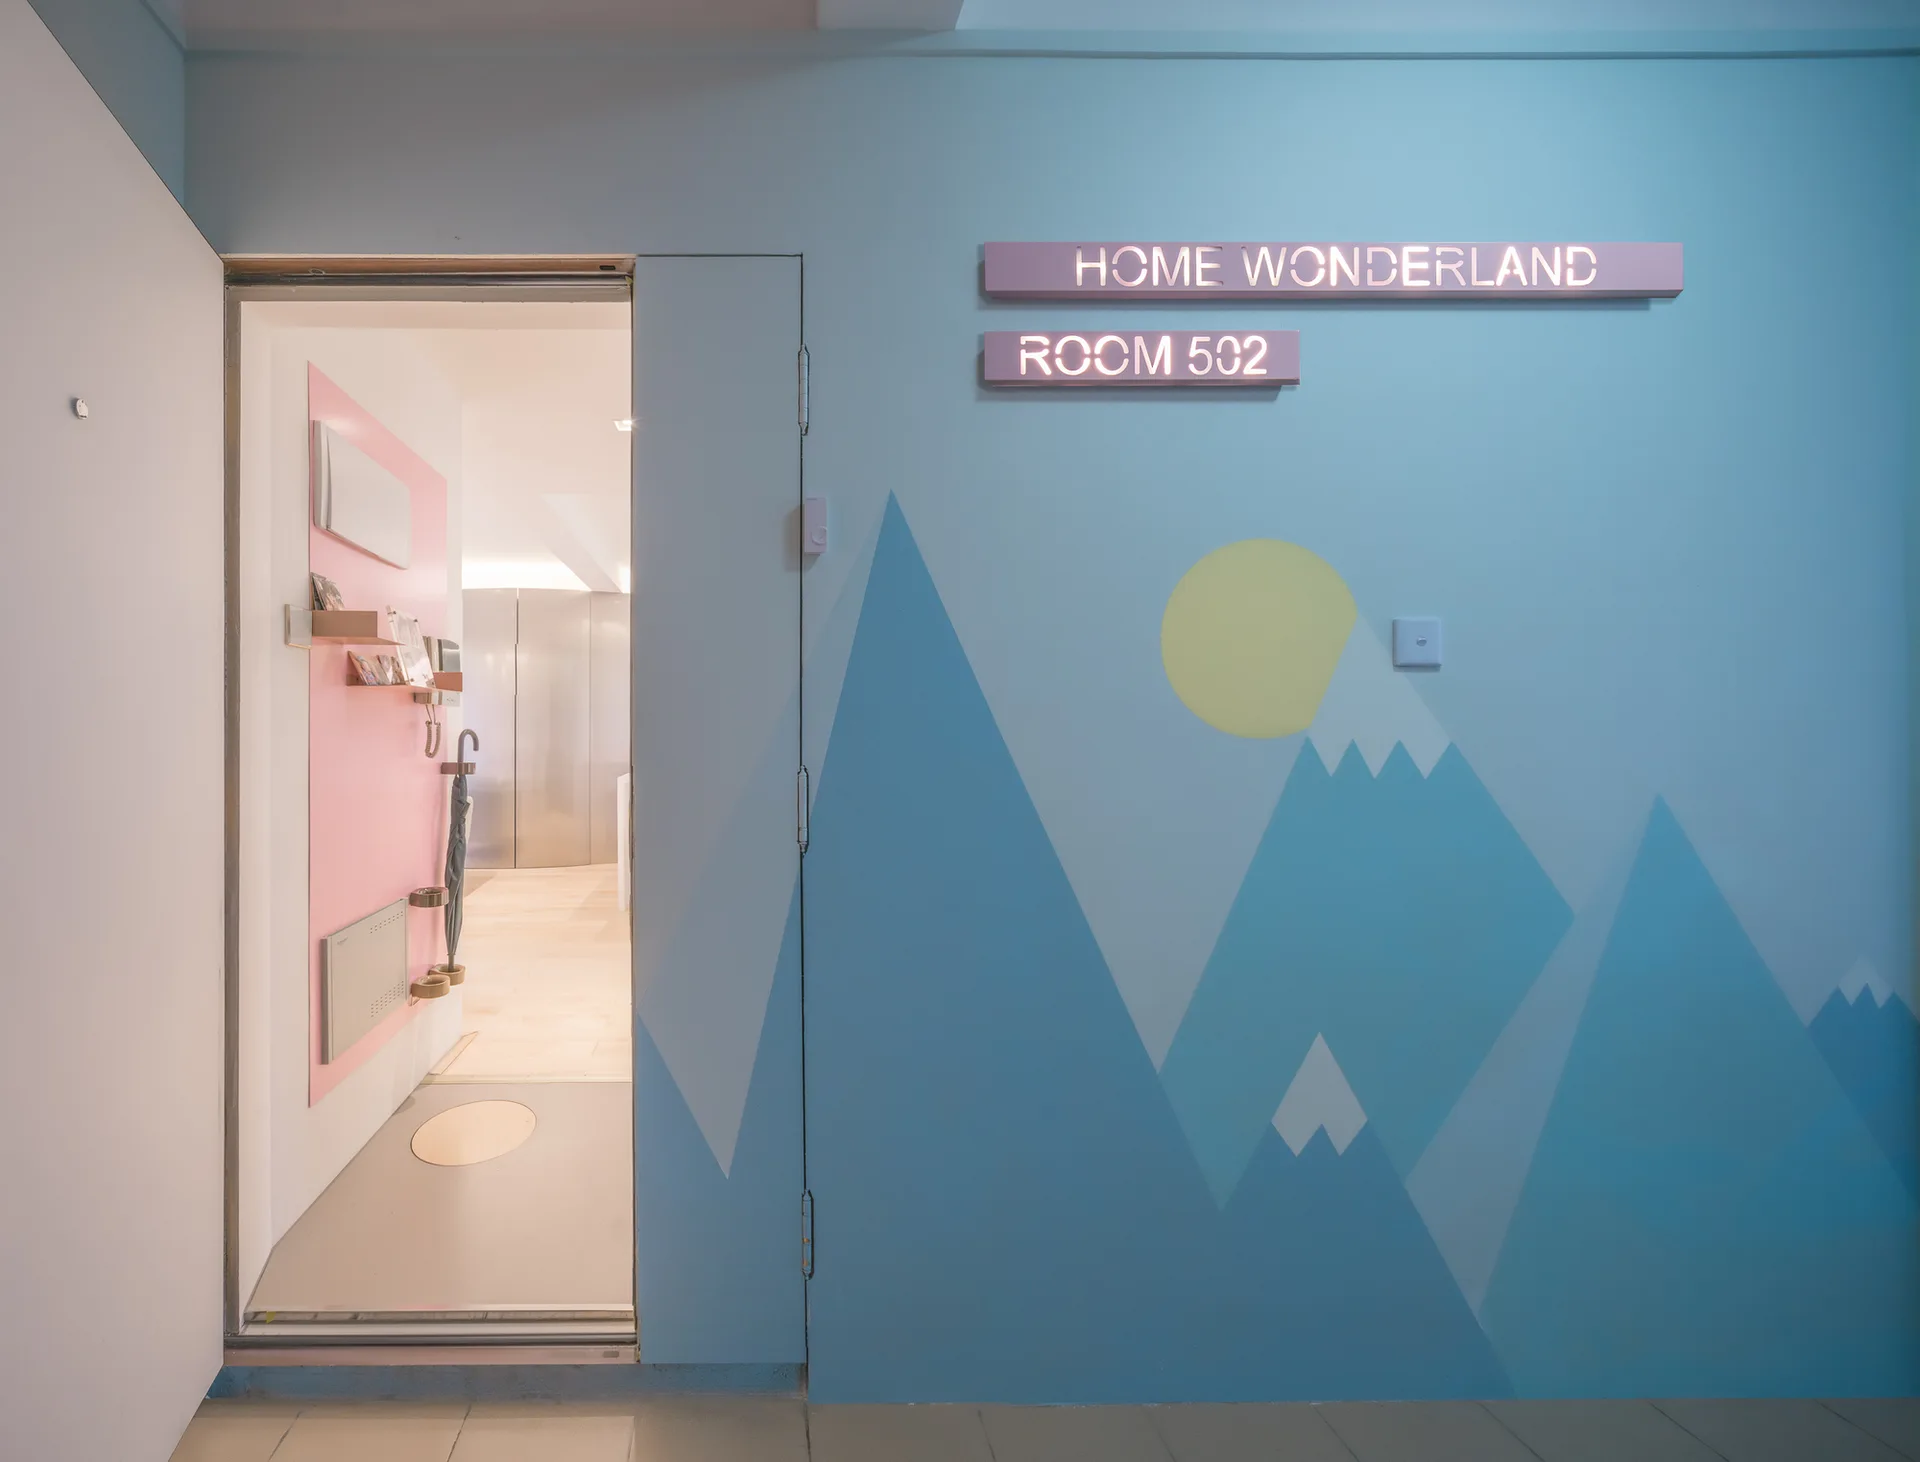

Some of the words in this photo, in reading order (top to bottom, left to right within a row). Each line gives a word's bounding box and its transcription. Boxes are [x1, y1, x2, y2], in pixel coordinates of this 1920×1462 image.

[1075, 245, 1223, 287] HOME
[1241, 245, 1598, 287] WONDERLAND
[1019, 335, 1172, 376] ROOM
[1187, 335, 1268, 376] 502
